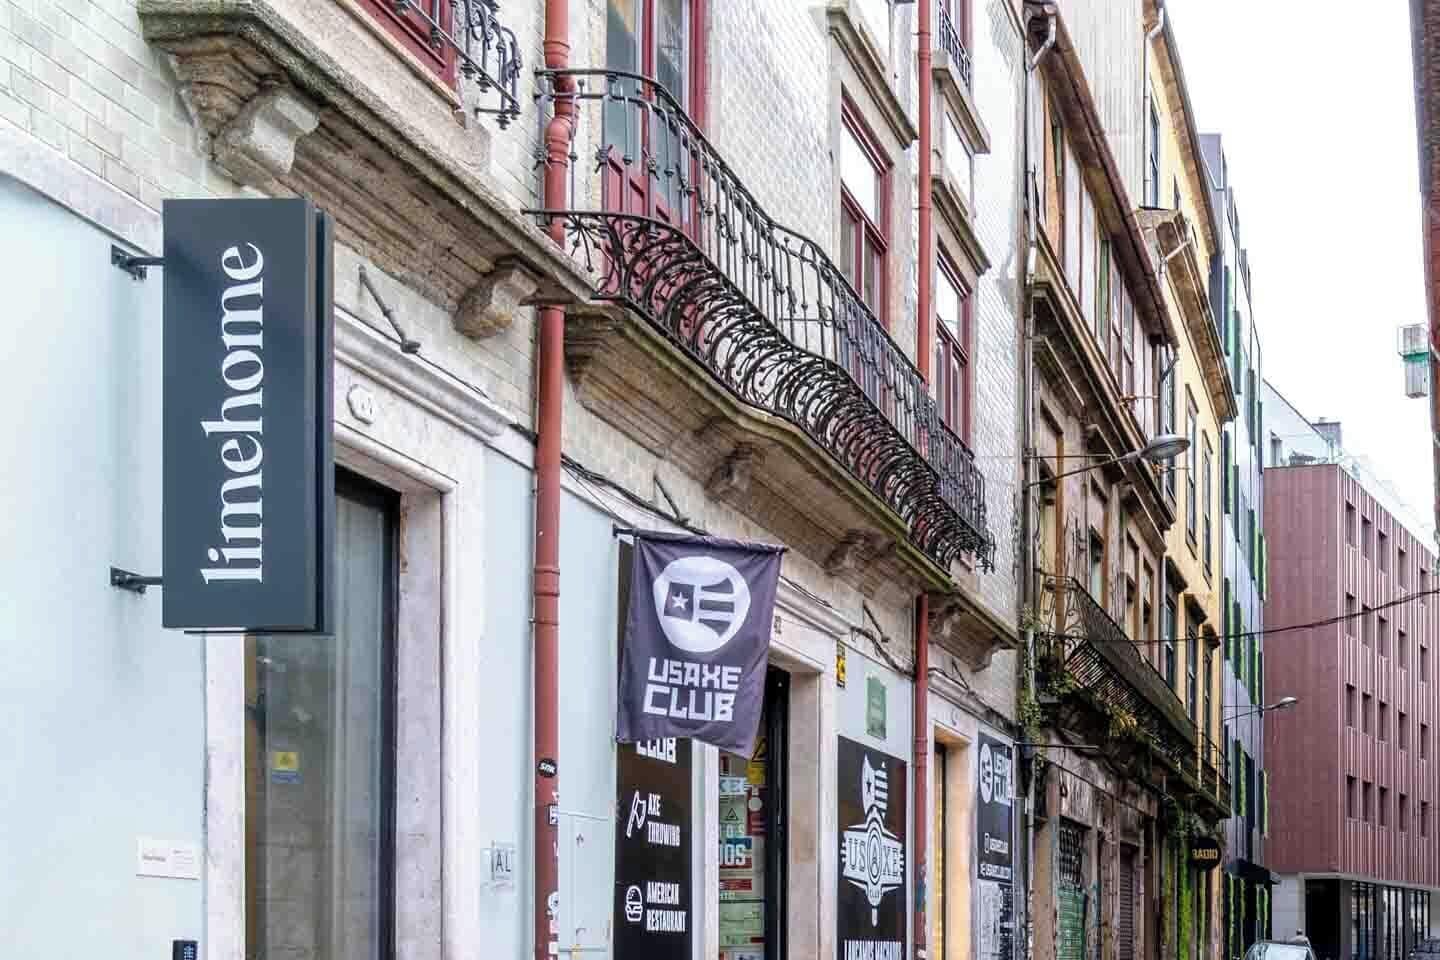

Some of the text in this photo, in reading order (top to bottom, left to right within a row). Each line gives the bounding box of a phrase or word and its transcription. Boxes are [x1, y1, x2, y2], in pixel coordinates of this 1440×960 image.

[200, 242, 263, 584] limehome
[647, 657, 742, 691] USAXE
[643, 683, 736, 721] CLUB
[647, 792, 661, 817] AXE
[647, 820, 681, 847] THROWING
[848, 838, 899, 877] USAXE
[646, 881, 680, 905] AMERICAN
[646, 909, 687, 932] RESTAURANT
